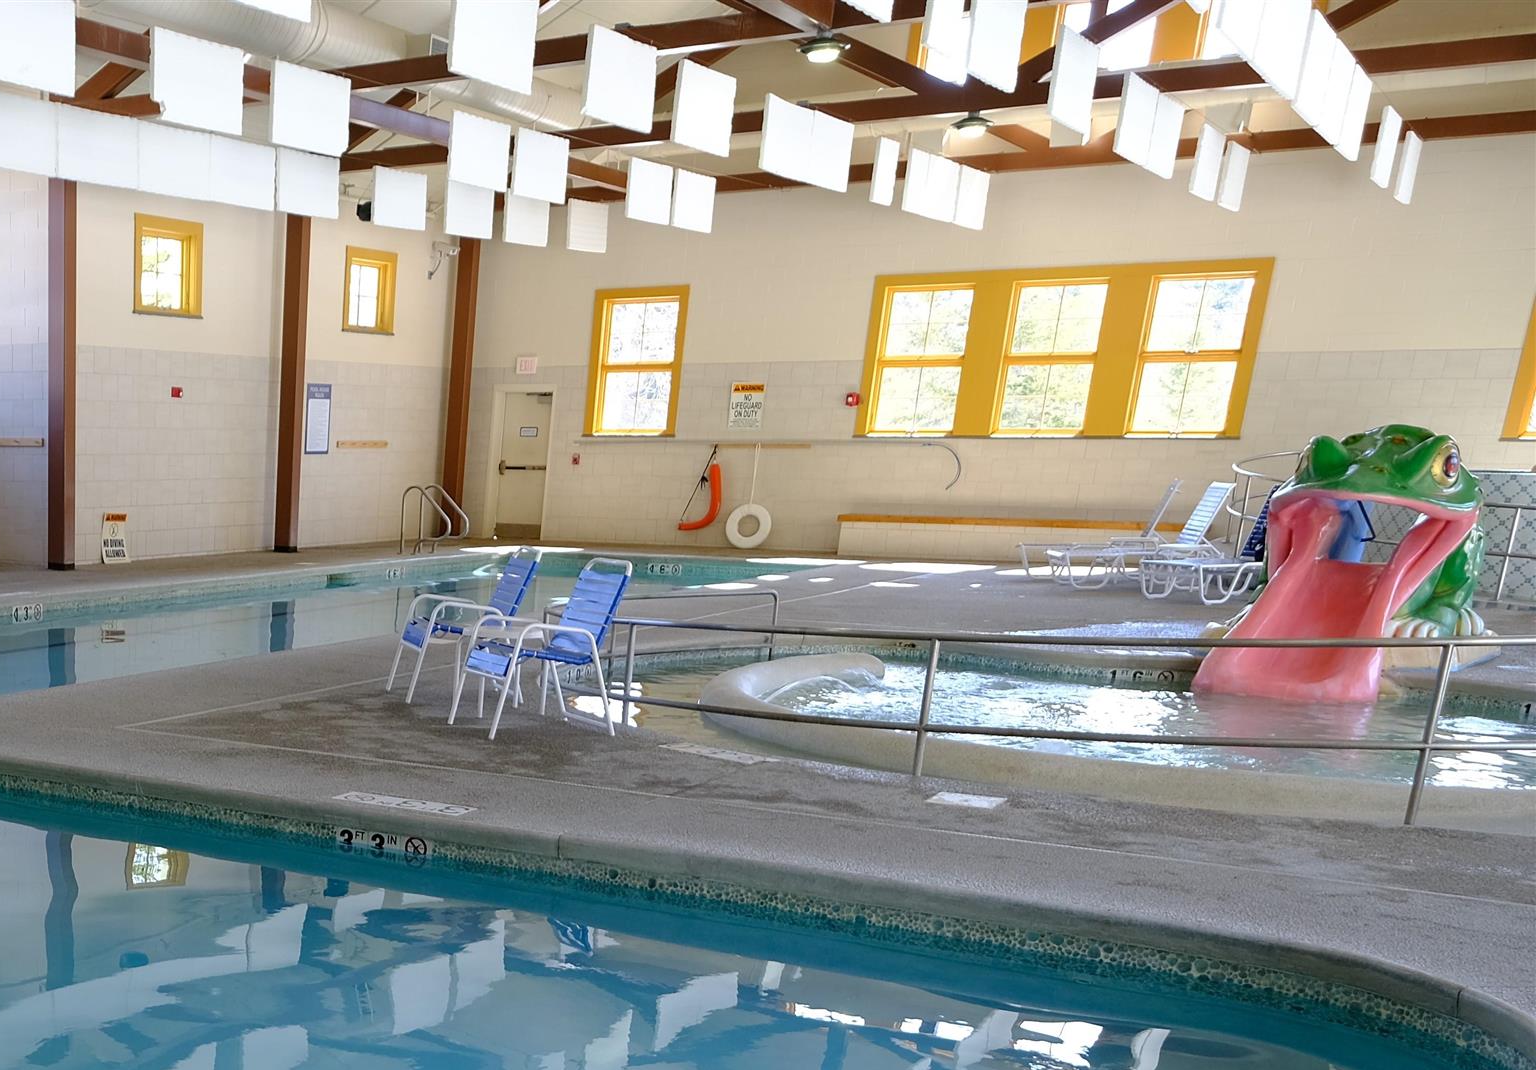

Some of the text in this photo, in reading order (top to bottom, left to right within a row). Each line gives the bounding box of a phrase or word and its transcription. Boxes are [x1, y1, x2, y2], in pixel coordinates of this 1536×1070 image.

[23, 606, 29, 621] 3
[354, 831, 366, 841] FT
[387, 834, 398, 846] IN
